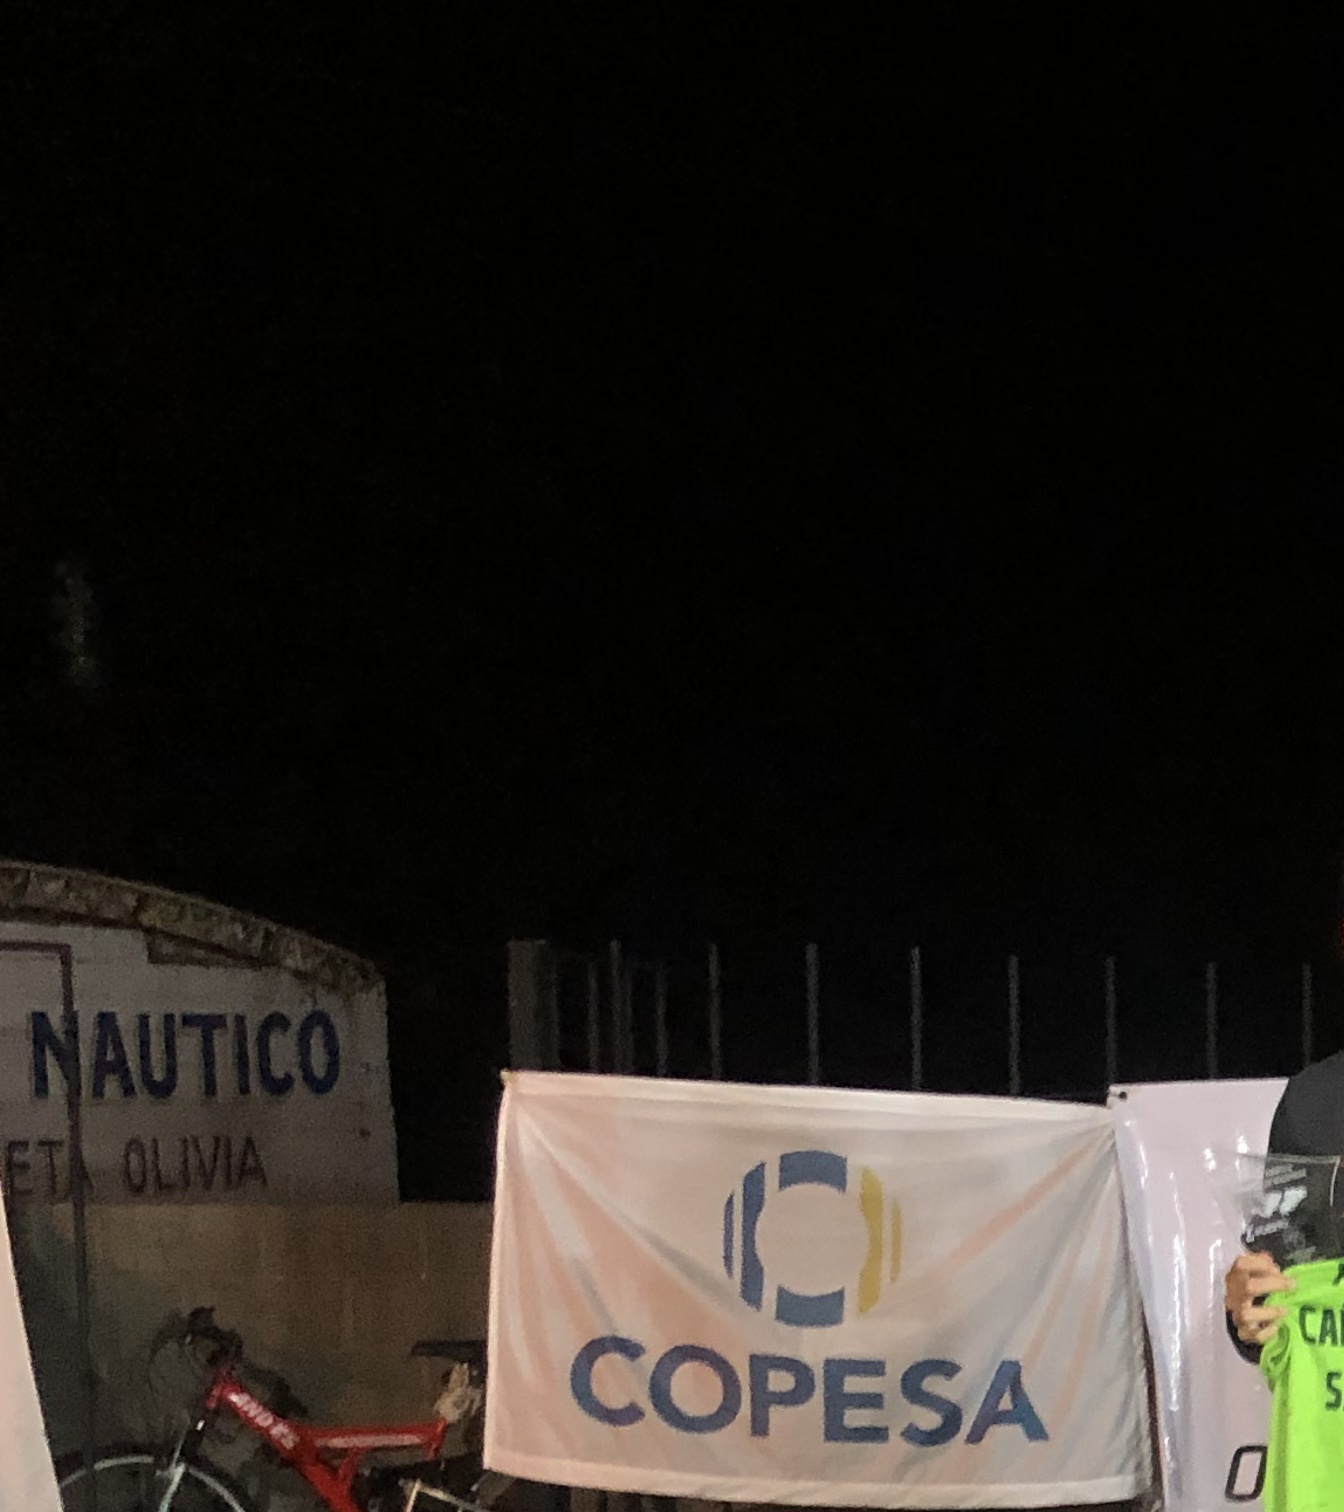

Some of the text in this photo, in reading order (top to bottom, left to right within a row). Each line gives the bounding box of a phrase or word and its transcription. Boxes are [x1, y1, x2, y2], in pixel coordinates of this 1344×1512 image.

[29, 1009, 341, 1100] NAUTICO
[122, 1134, 268, 1194] OLIVIA
[569, 1334, 1050, 1448] COPESA
